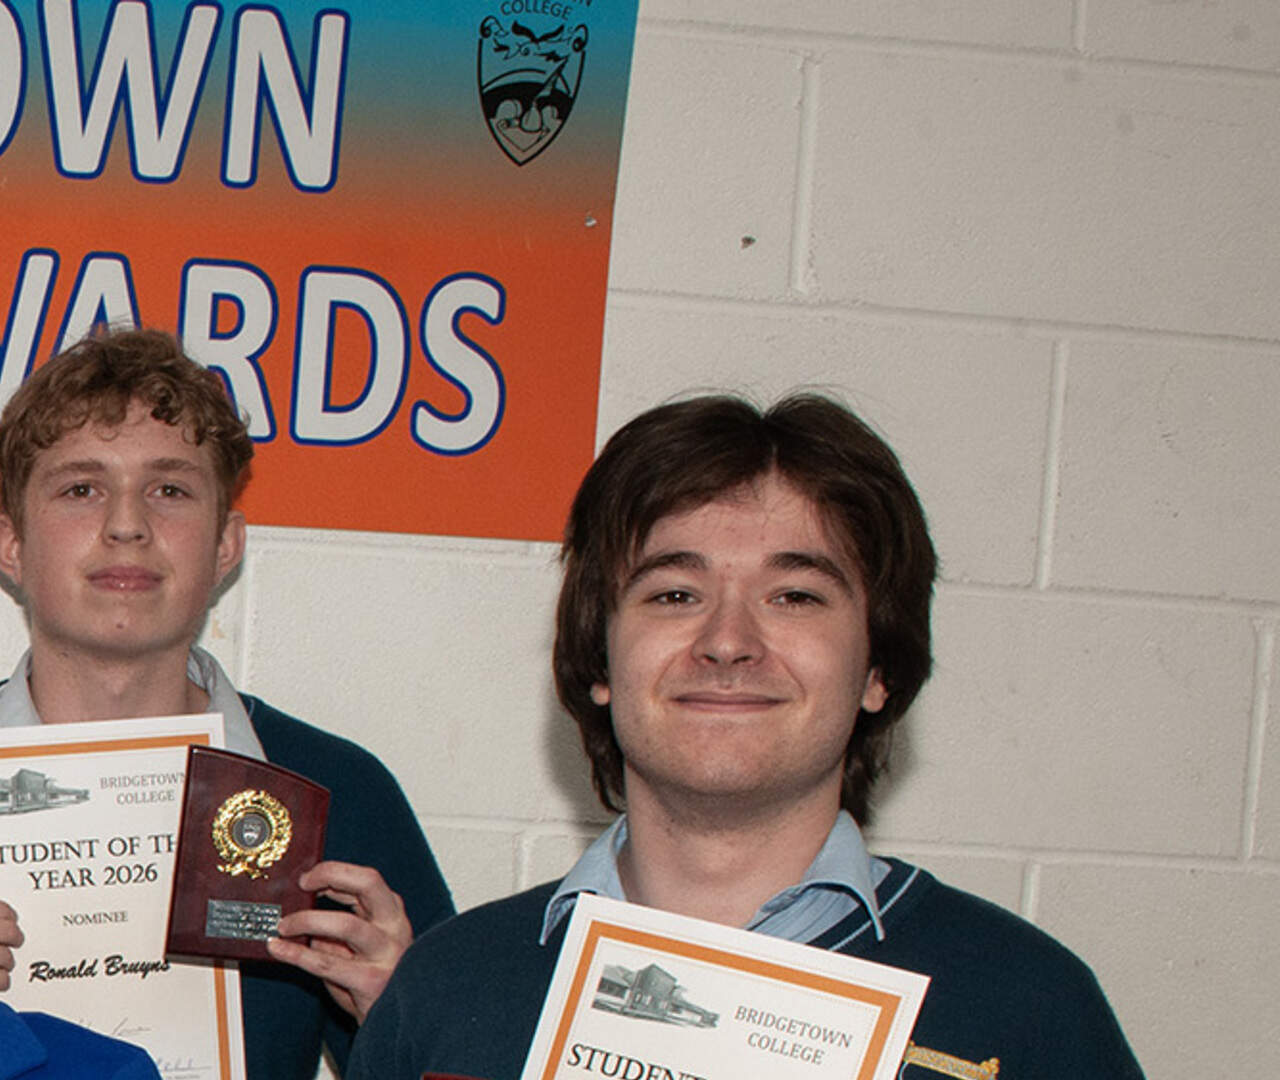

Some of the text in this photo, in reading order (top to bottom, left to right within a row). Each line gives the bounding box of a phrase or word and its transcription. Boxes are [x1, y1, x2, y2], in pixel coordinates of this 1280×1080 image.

[500, 0, 573, 21] COLLEGE
[116, 789, 175, 805] COLLEGE
[107, 837, 141, 857] OF
[28, 863, 158, 891] YEAR 2026
[62, 911, 129, 926] NOMINEE
[29, 954, 172, 983] Ronald Bruyns
[734, 1005, 854, 1049] BRIDGETOWN
[746, 1031, 827, 1066] COLLEGE
